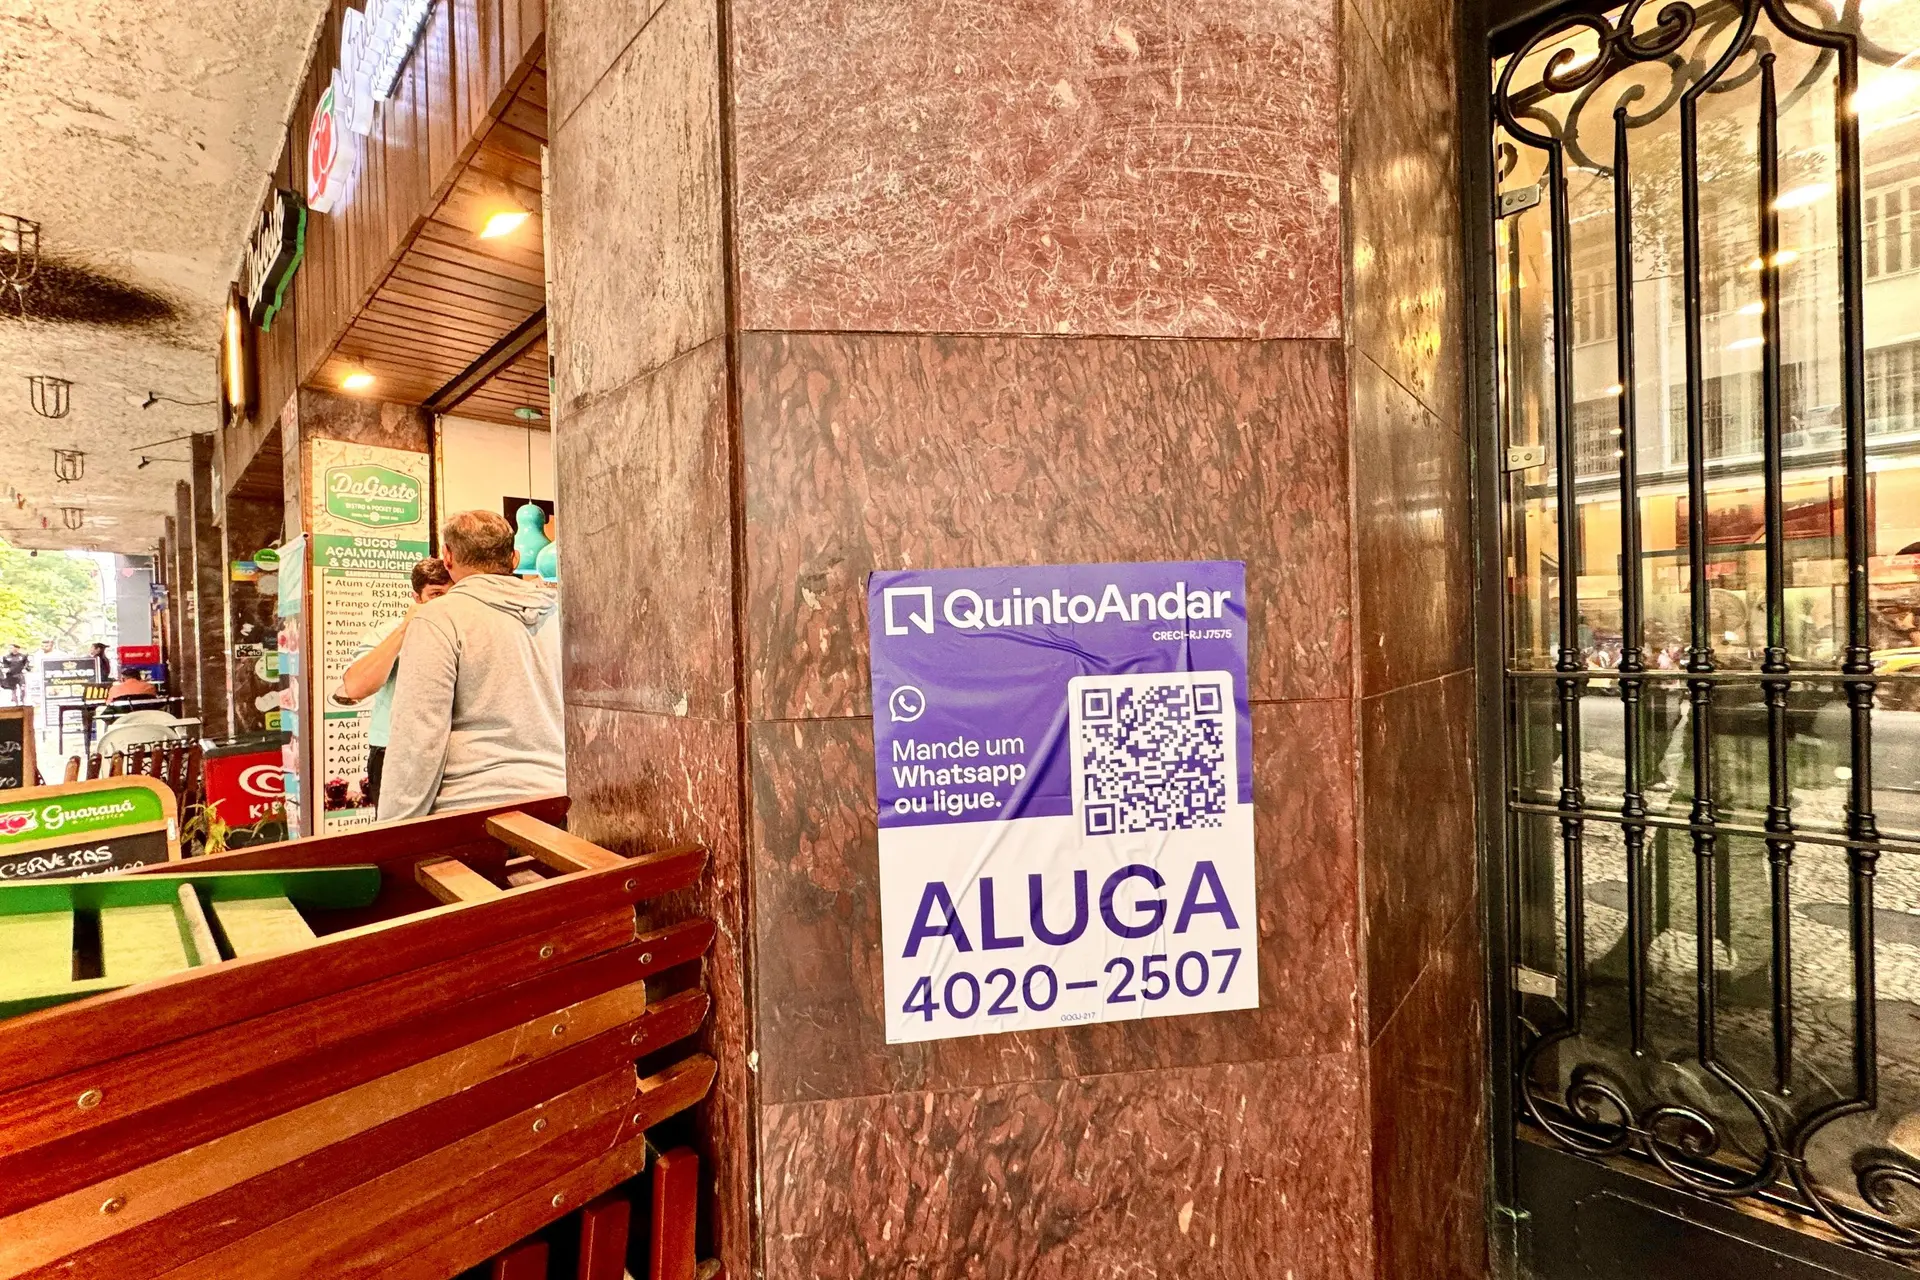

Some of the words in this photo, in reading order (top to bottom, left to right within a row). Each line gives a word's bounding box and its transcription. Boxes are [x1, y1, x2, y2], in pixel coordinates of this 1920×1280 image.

[330, 473, 418, 503] DaGosto
[354, 537, 397, 549] SUCOS
[329, 558, 339, 567] &
[335, 579, 363, 587] Atum
[335, 600, 369, 609] Frango
[372, 600, 409, 609] c/milho
[943, 581, 1232, 631] QuintoAndar
[335, 619, 367, 627] Minas
[1152, 629, 1202, 641] CRECI-RJ
[1203, 629, 1233, 639] J7575
[337, 719, 360, 729] Açaí
[338, 731, 360, 740] Açaí
[338, 742, 360, 752] Açaí
[892, 736, 980, 762] Mande
[986, 737, 1024, 756] um
[338, 754, 360, 764] Açaí
[338, 765, 360, 776] Açaí
[892, 763, 1026, 789] Whatsapp
[894, 796, 927, 815] ou
[933, 789, 1002, 816] ligue.
[41, 799, 136, 830] Guaraná
[901, 860, 1240, 958] ALUGA
